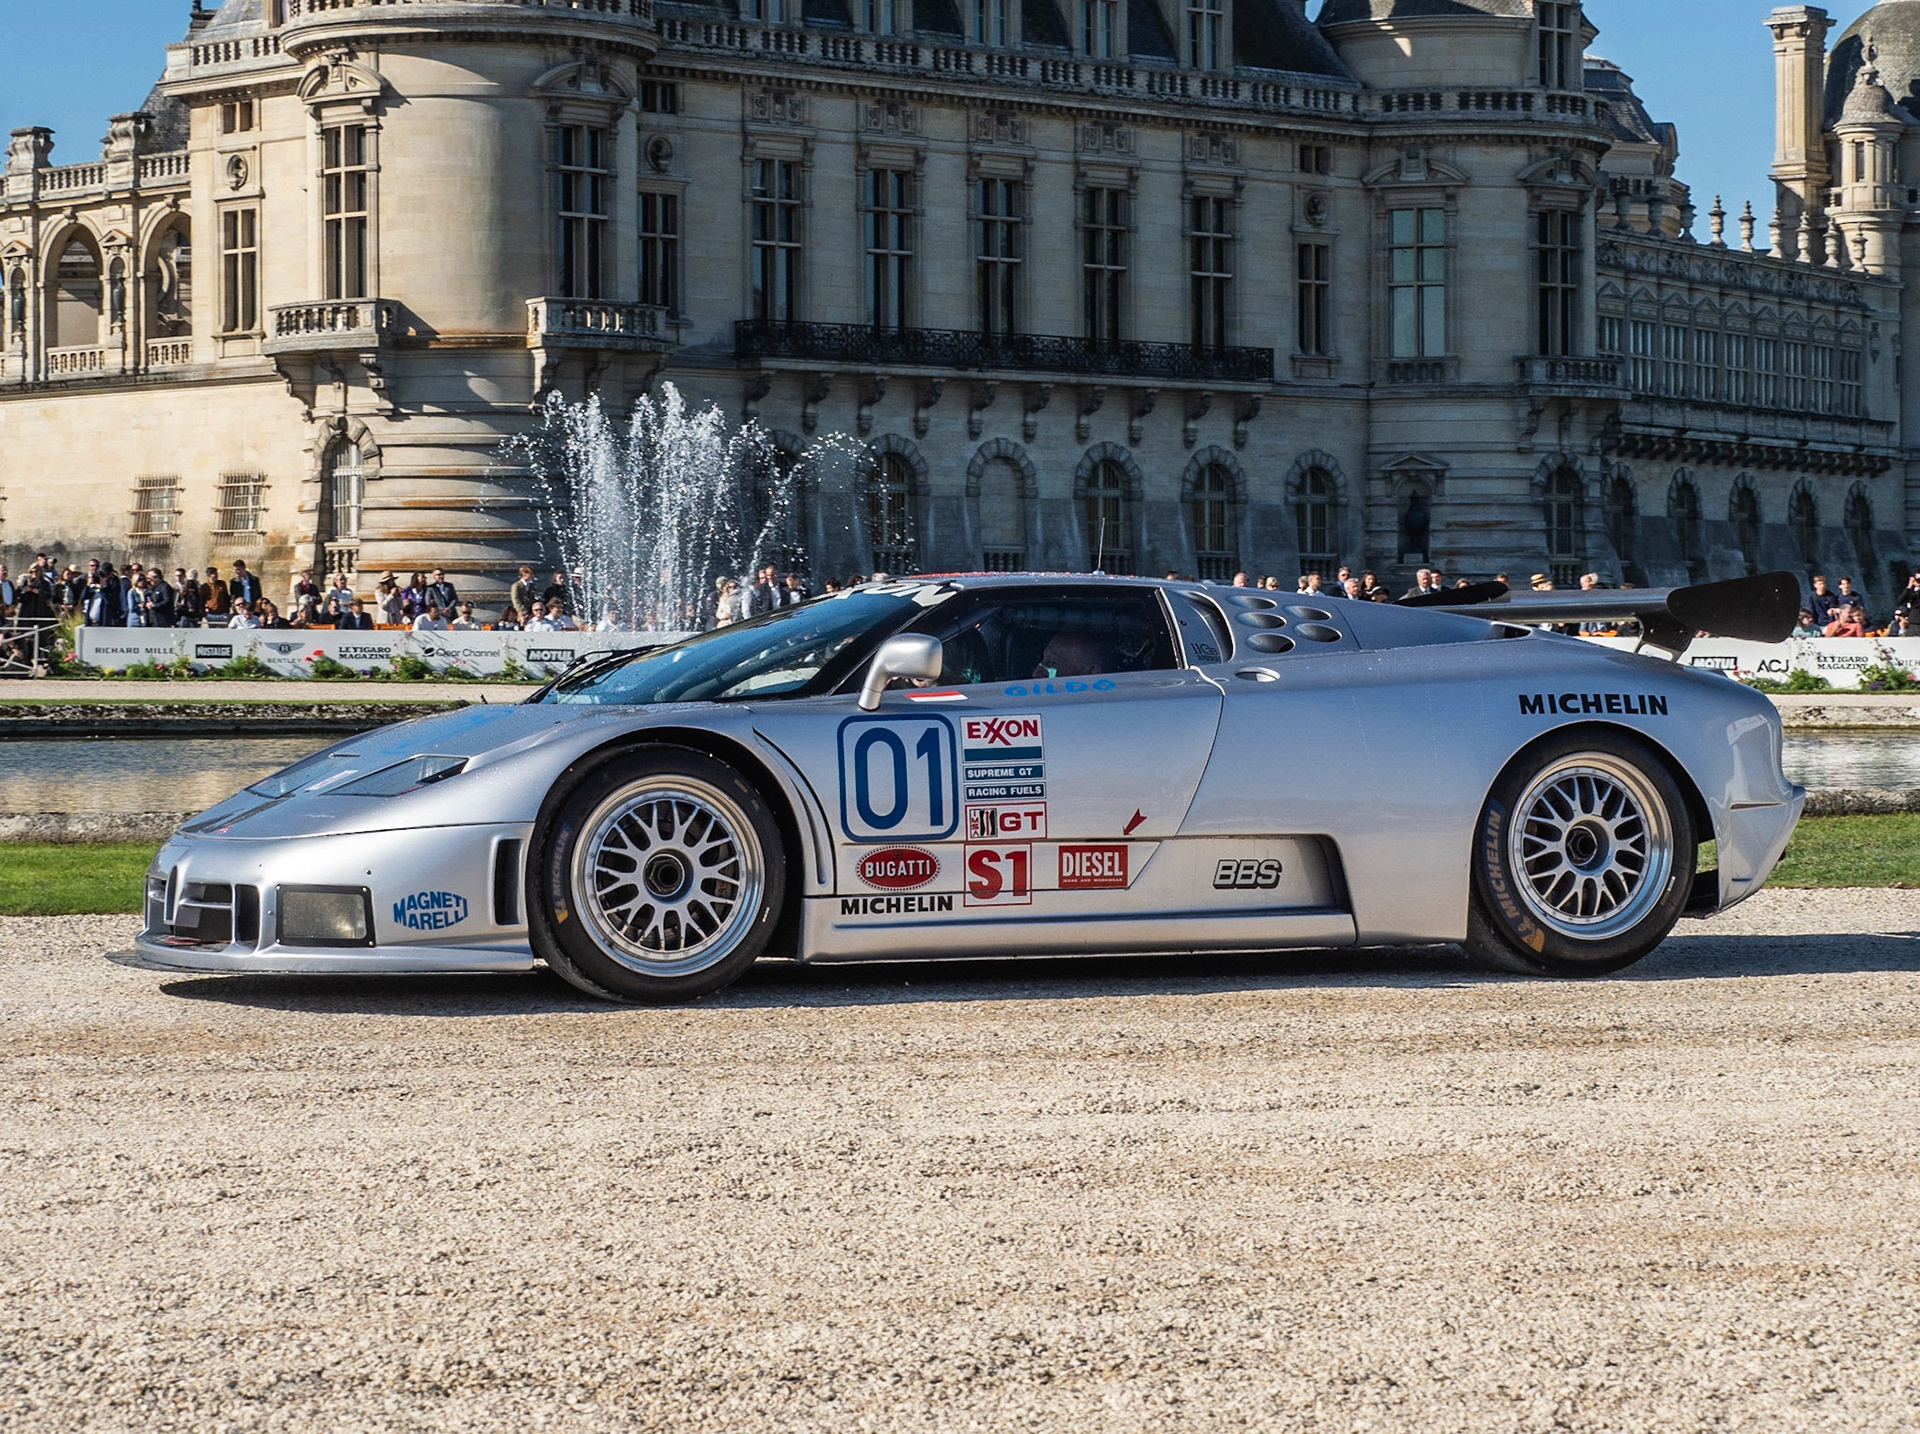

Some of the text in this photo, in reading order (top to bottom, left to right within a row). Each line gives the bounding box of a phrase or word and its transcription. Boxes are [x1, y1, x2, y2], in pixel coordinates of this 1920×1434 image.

[436, 647, 500, 657] Clear Channel
[529, 650, 573, 661] MOTUL
[1693, 657, 1736, 670] MOTUL
[1757, 659, 1790, 673] ACJ
[1004, 679, 1116, 697] GILDO
[1518, 693, 1668, 716] MICHELIN
[967, 717, 1039, 746] EXXON
[854, 727, 944, 830] 01
[967, 767, 1033, 779] SUPREME GT
[968, 786, 1042, 797] RACING FUELS
[999, 811, 1044, 832] GT
[865, 859, 931, 878] BUGATTI
[967, 849, 1029, 900] S1
[1062, 851, 1124, 877] DIESEL
[1213, 859, 1283, 889] BBS
[1486, 809, 1520, 919] MICHELIN
[393, 891, 469, 918] MAGNETI
[841, 895, 953, 915] MICHELIN
[393, 906, 469, 930] MARELLI
